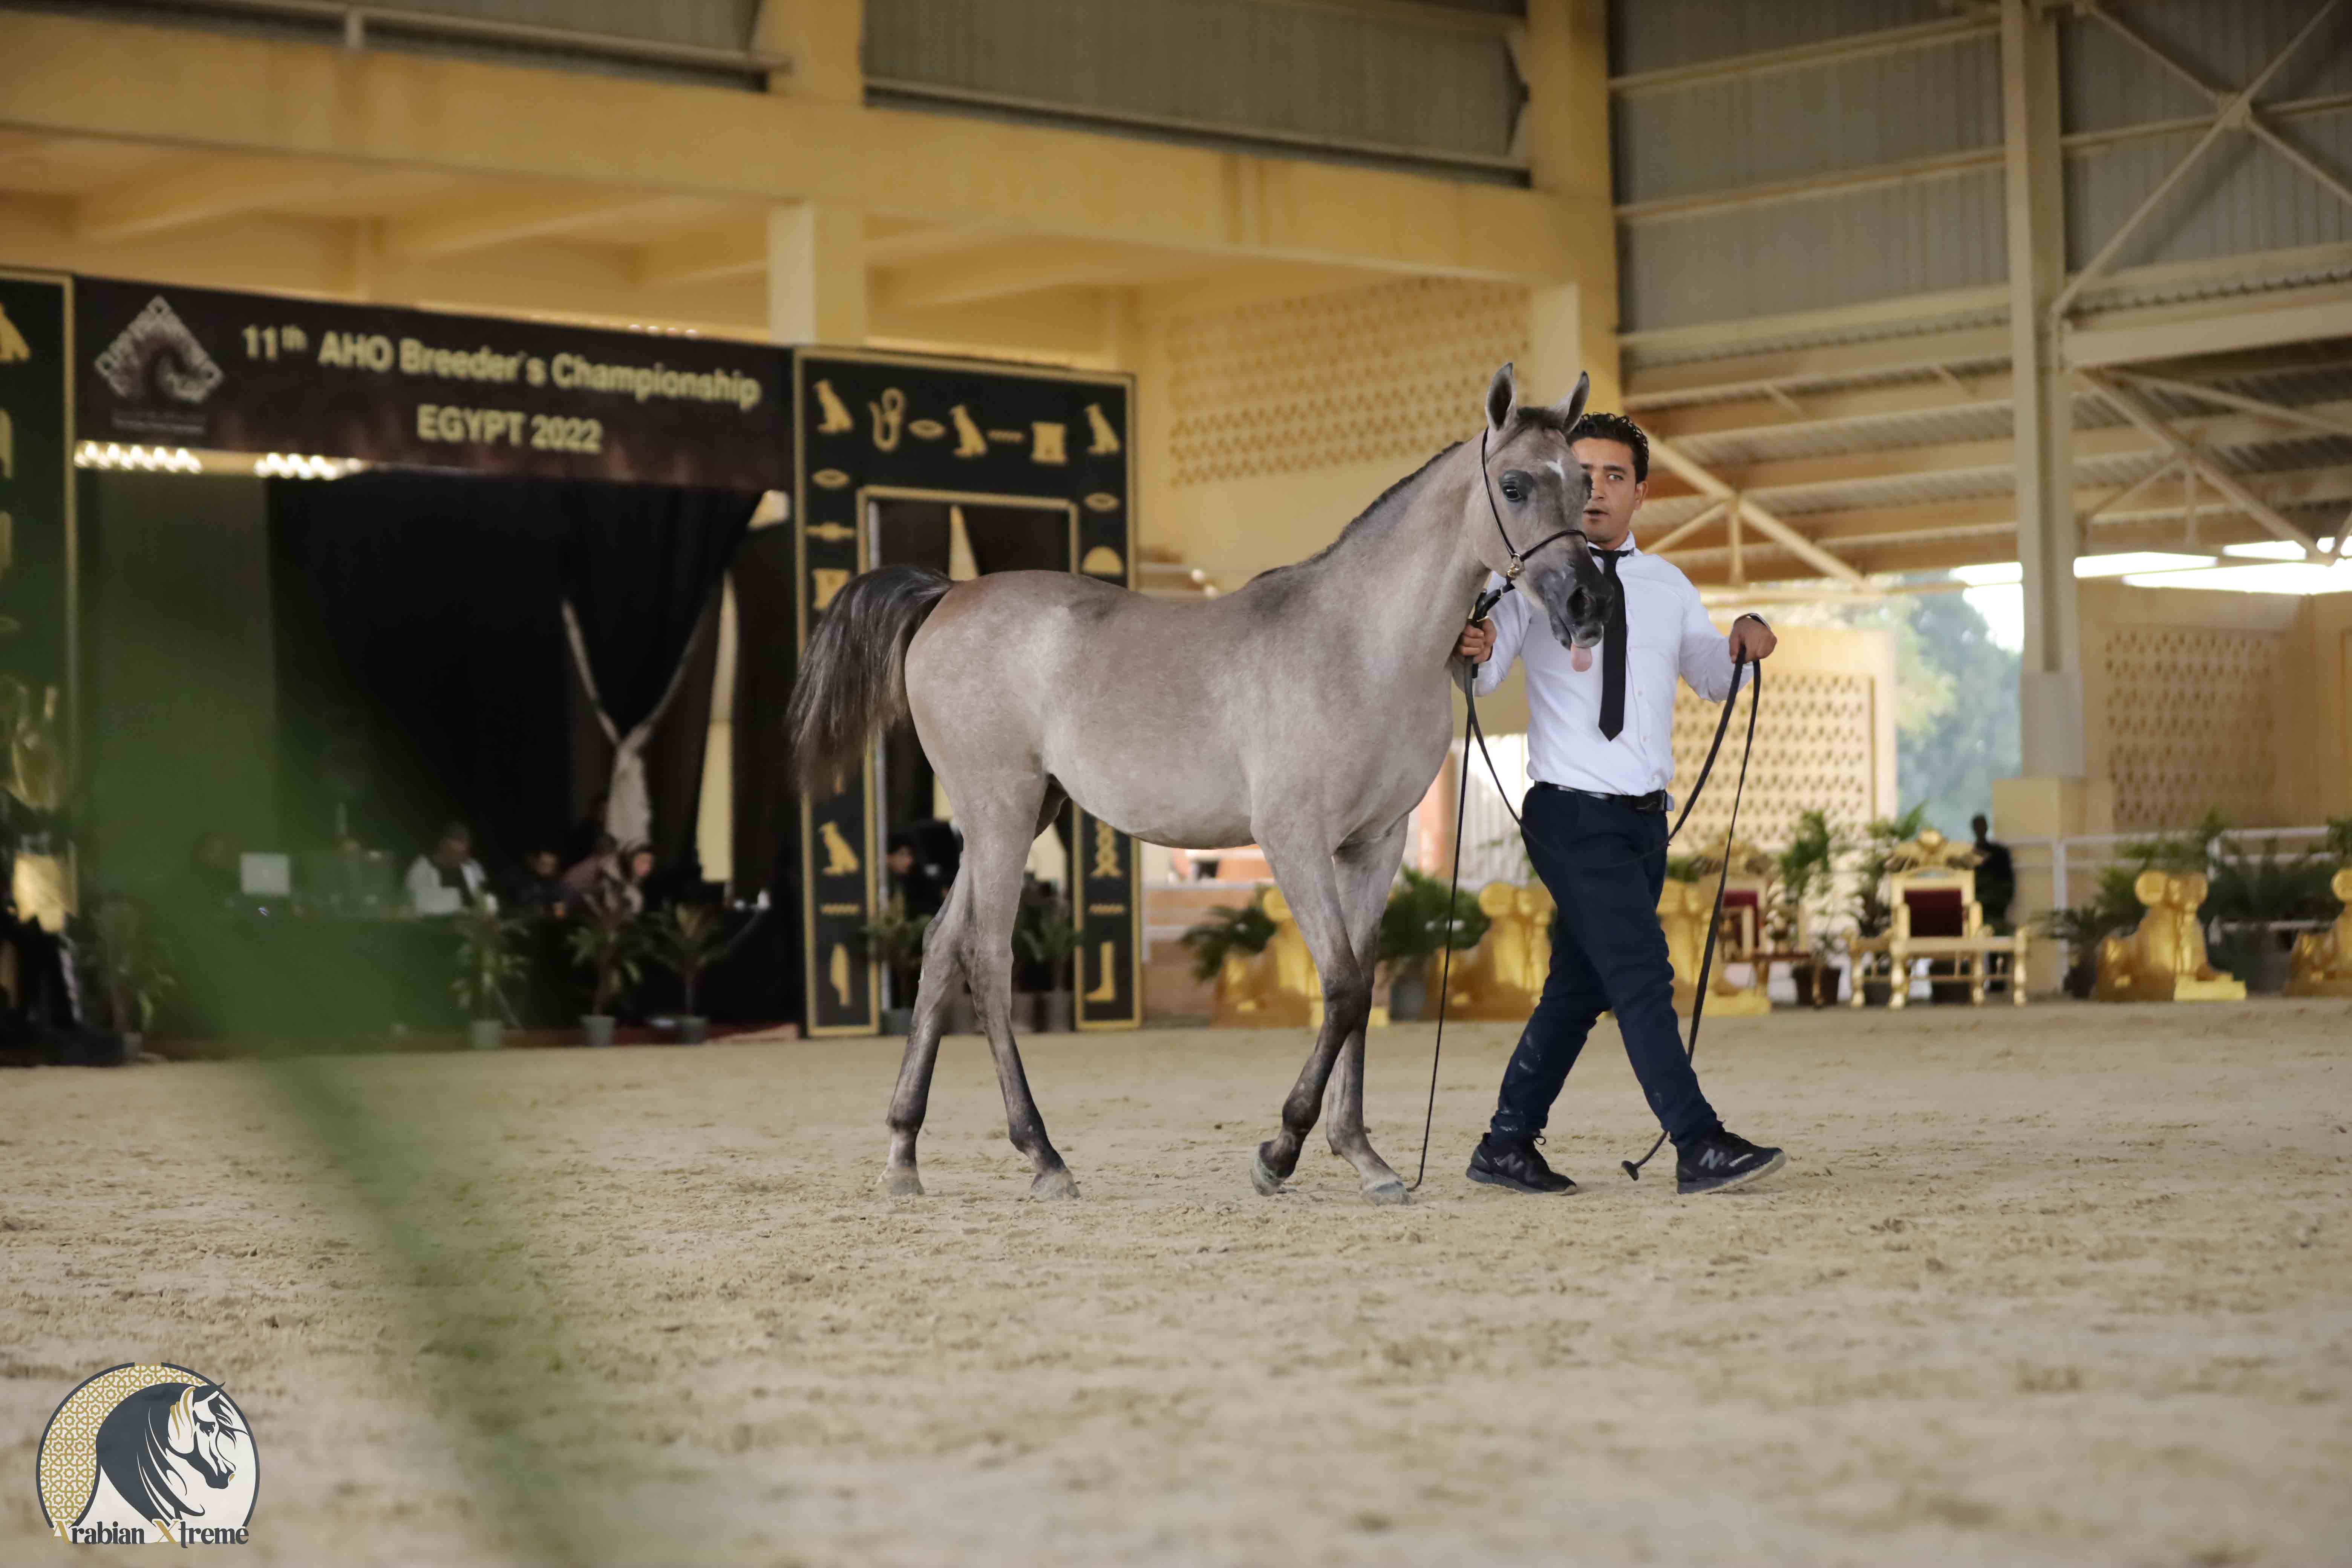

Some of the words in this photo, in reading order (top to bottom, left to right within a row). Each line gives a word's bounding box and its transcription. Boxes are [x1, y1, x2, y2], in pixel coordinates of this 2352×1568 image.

[317, 330, 394, 372] AHO
[551, 352, 761, 410] Championship
[417, 403, 526, 447] EGYPT
[531, 414, 602, 453] 2022
